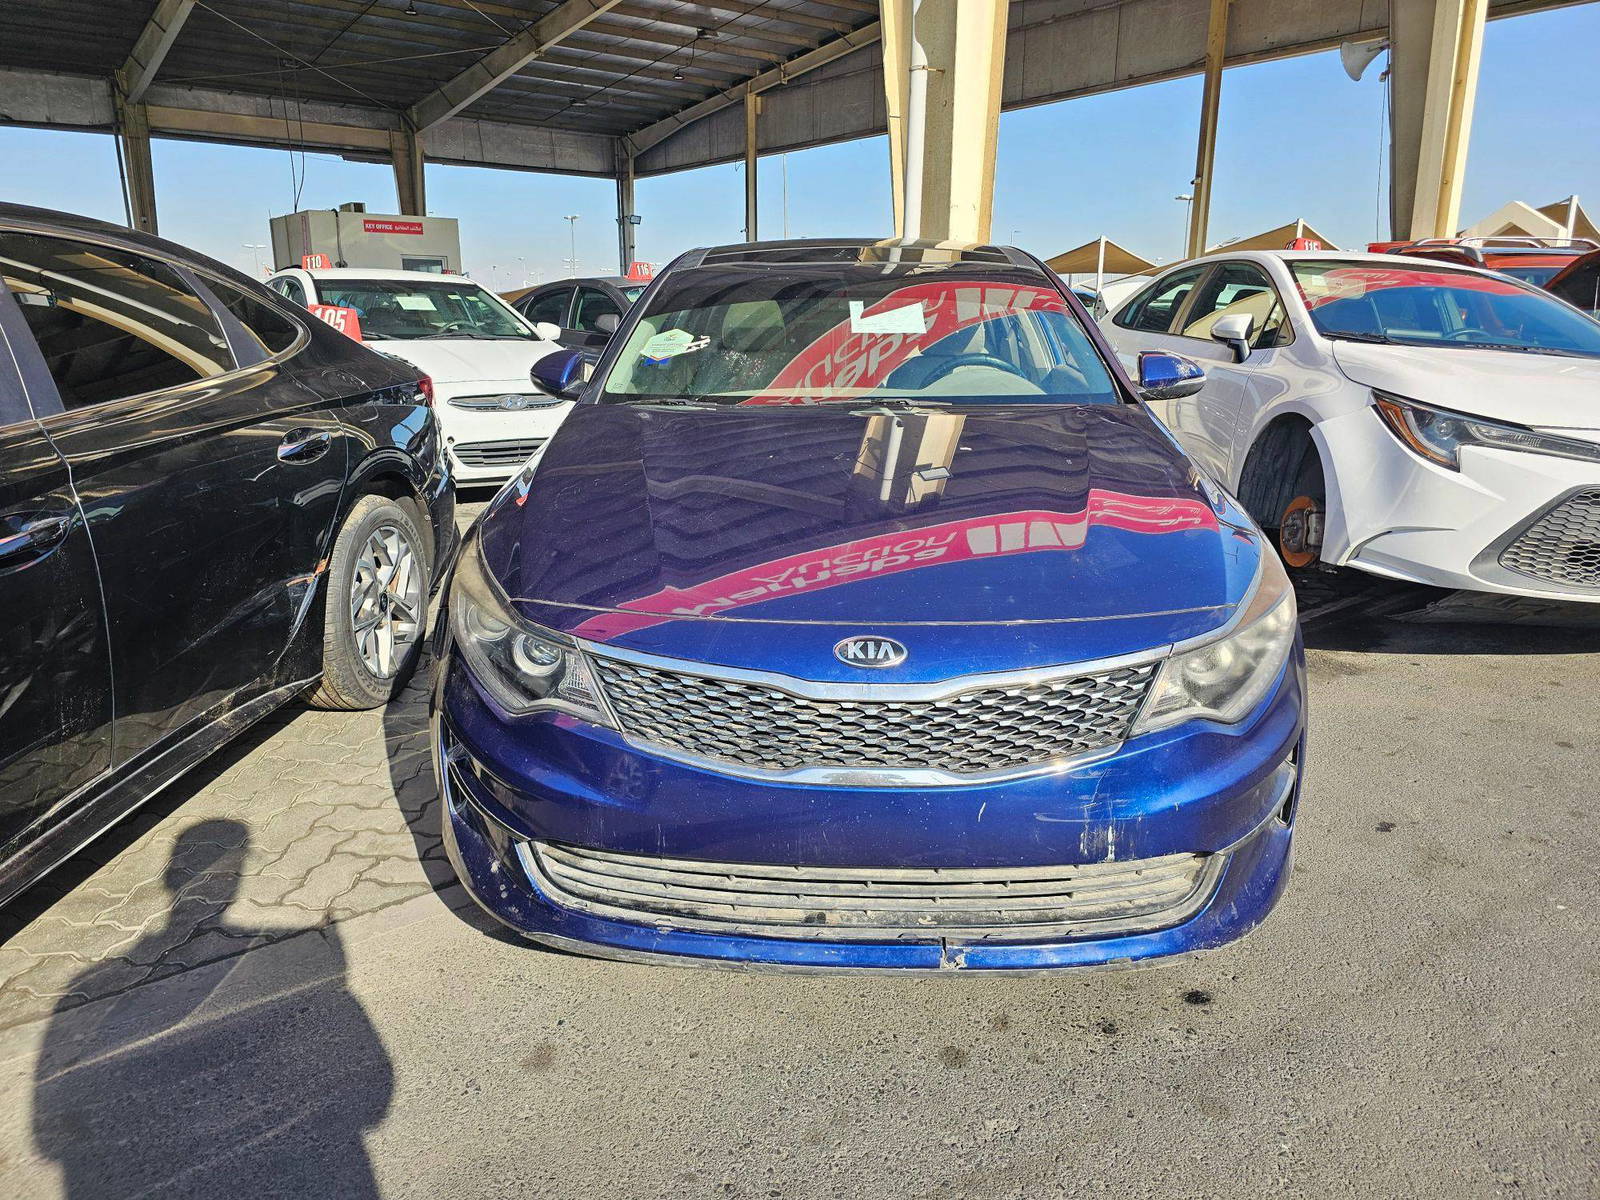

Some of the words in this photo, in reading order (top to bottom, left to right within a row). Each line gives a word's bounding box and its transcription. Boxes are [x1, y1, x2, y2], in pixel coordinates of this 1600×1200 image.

[375, 223, 393, 231] OFFICE
[306, 256, 322, 270] 110
[847, 641, 896, 659] KIA
